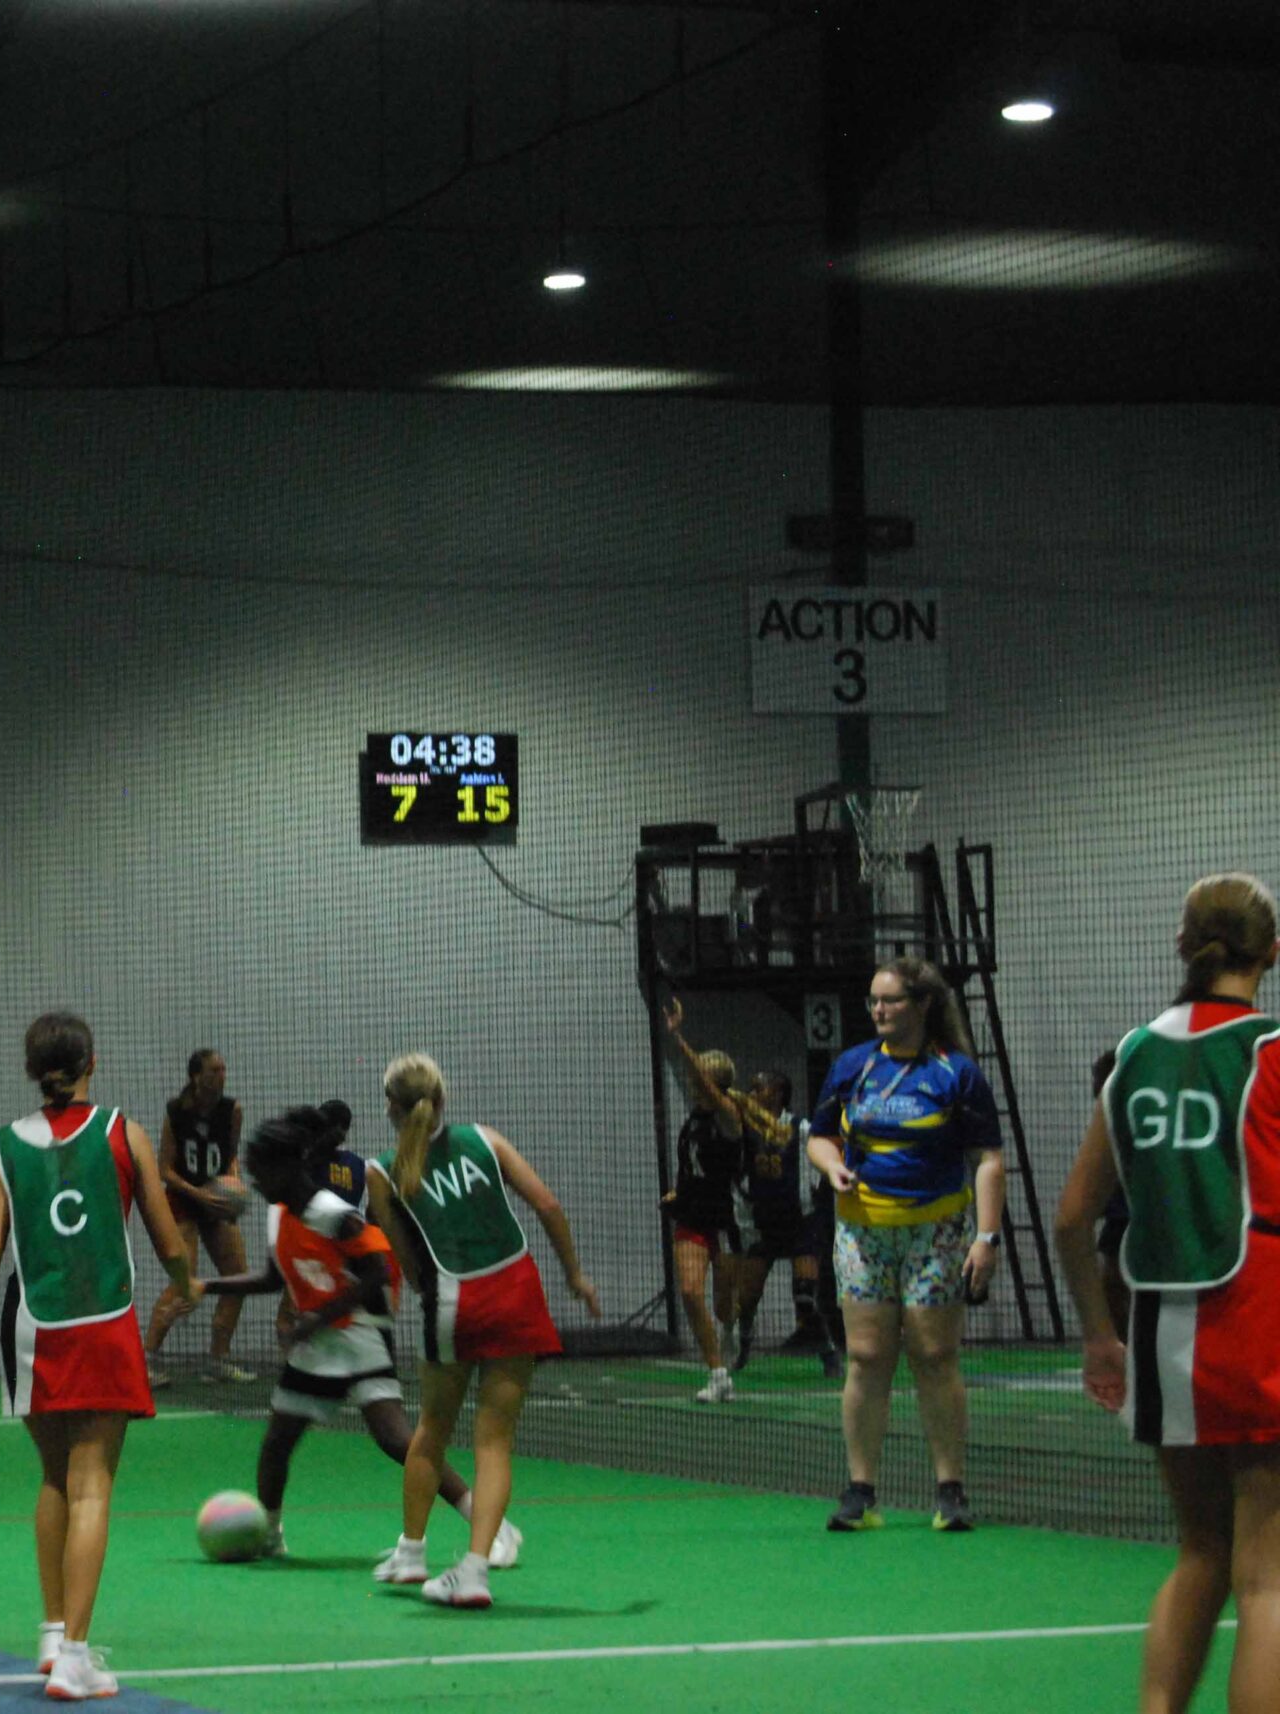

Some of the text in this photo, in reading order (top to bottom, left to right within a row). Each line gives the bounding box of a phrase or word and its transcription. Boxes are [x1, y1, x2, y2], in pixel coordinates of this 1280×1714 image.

[757, 598, 937, 642] ACTION
[833, 647, 868, 702] 3
[390, 733, 496, 767] 04:38
[391, 785, 417, 823] 7
[457, 785, 510, 823] 15
[810, 1002, 834, 1042] 3
[1126, 1087, 1220, 1150] GD
[420, 1154, 491, 1209] WA
[48, 1188, 88, 1237] C
